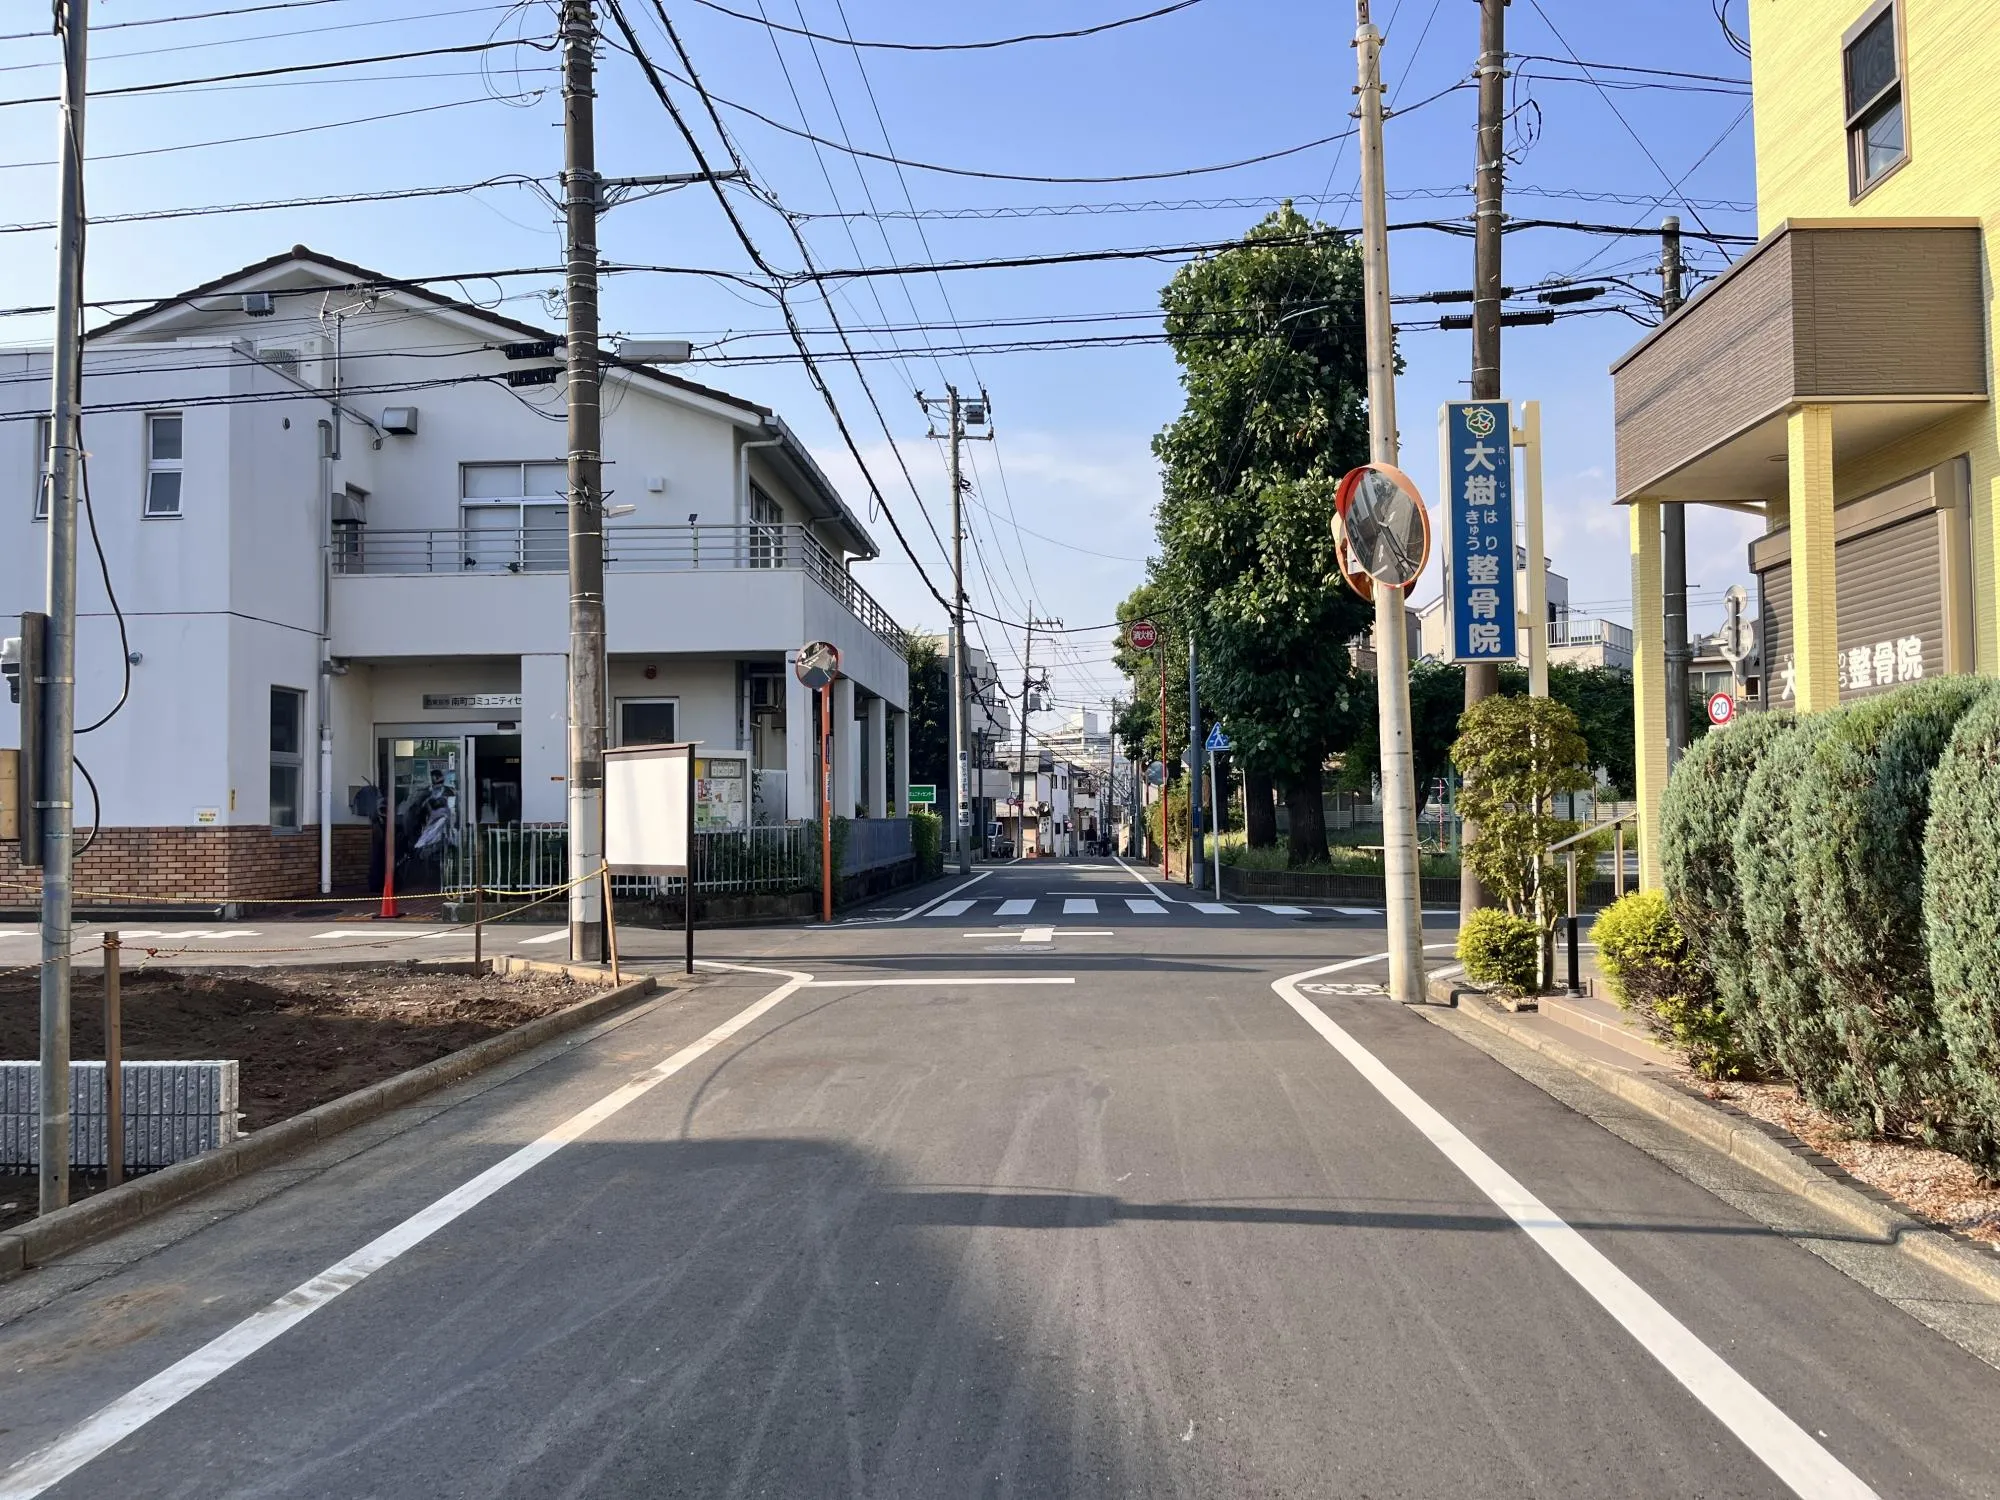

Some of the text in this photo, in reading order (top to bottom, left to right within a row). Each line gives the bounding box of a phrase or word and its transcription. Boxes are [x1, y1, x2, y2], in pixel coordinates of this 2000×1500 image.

[1463, 440, 1497, 506] 大樹
[1466, 511, 1480, 550] きゅう
[1484, 510, 1498, 550] はり
[1467, 554, 1501, 654] 整骨院
[1133, 630, 1154, 640] 消火栓
[1848, 635, 1923, 689] 整骨院
[1714, 701, 1727, 716] 20
